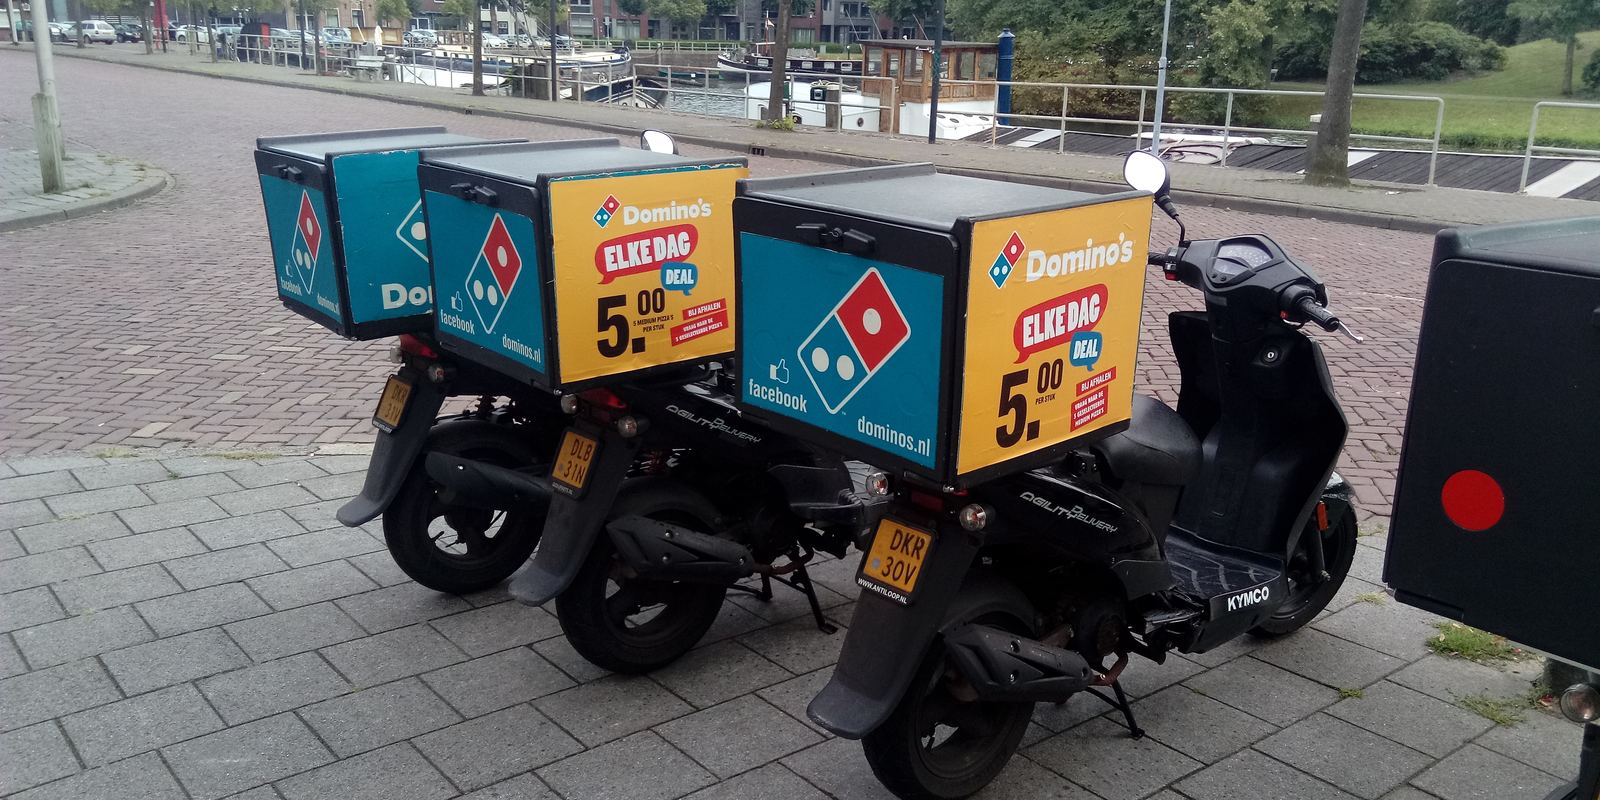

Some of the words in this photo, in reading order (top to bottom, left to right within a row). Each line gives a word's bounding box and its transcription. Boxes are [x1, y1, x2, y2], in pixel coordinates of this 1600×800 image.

[623, 198, 712, 226] Domino's
[603, 238, 653, 273] ELKE
[653, 231, 691, 262] DAG
[1026, 232, 1133, 283] Domino's
[665, 268, 694, 285] DEAL
[440, 308, 475, 336] facebook
[637, 317, 656, 326] MEDIUM
[688, 308, 697, 317] BIJ
[697, 301, 721, 315] AFHALEN
[1022, 304, 1066, 348] ELKE
[1067, 293, 1100, 333] DAG
[502, 333, 541, 364] dominos.nl
[1073, 338, 1099, 360] DEAL
[1081, 380, 1090, 392] BIJ
[1090, 370, 1112, 388] AFHALEN
[748, 378, 808, 413] facebook
[1035, 396, 1044, 405] PER
[1044, 393, 1056, 403] STUK
[712, 417, 762, 443] DELIVERY
[857, 415, 931, 457] dominos.nl
[570, 438, 593, 461] DLB
[563, 460, 586, 484] 31N
[1071, 505, 1118, 533] DELIVERY
[889, 528, 926, 560] DKR
[881, 556, 917, 586] 30V
[857, 578, 908, 605] WWW.ANTILOOP.NL
[1227, 586, 1270, 612] KYMCO
